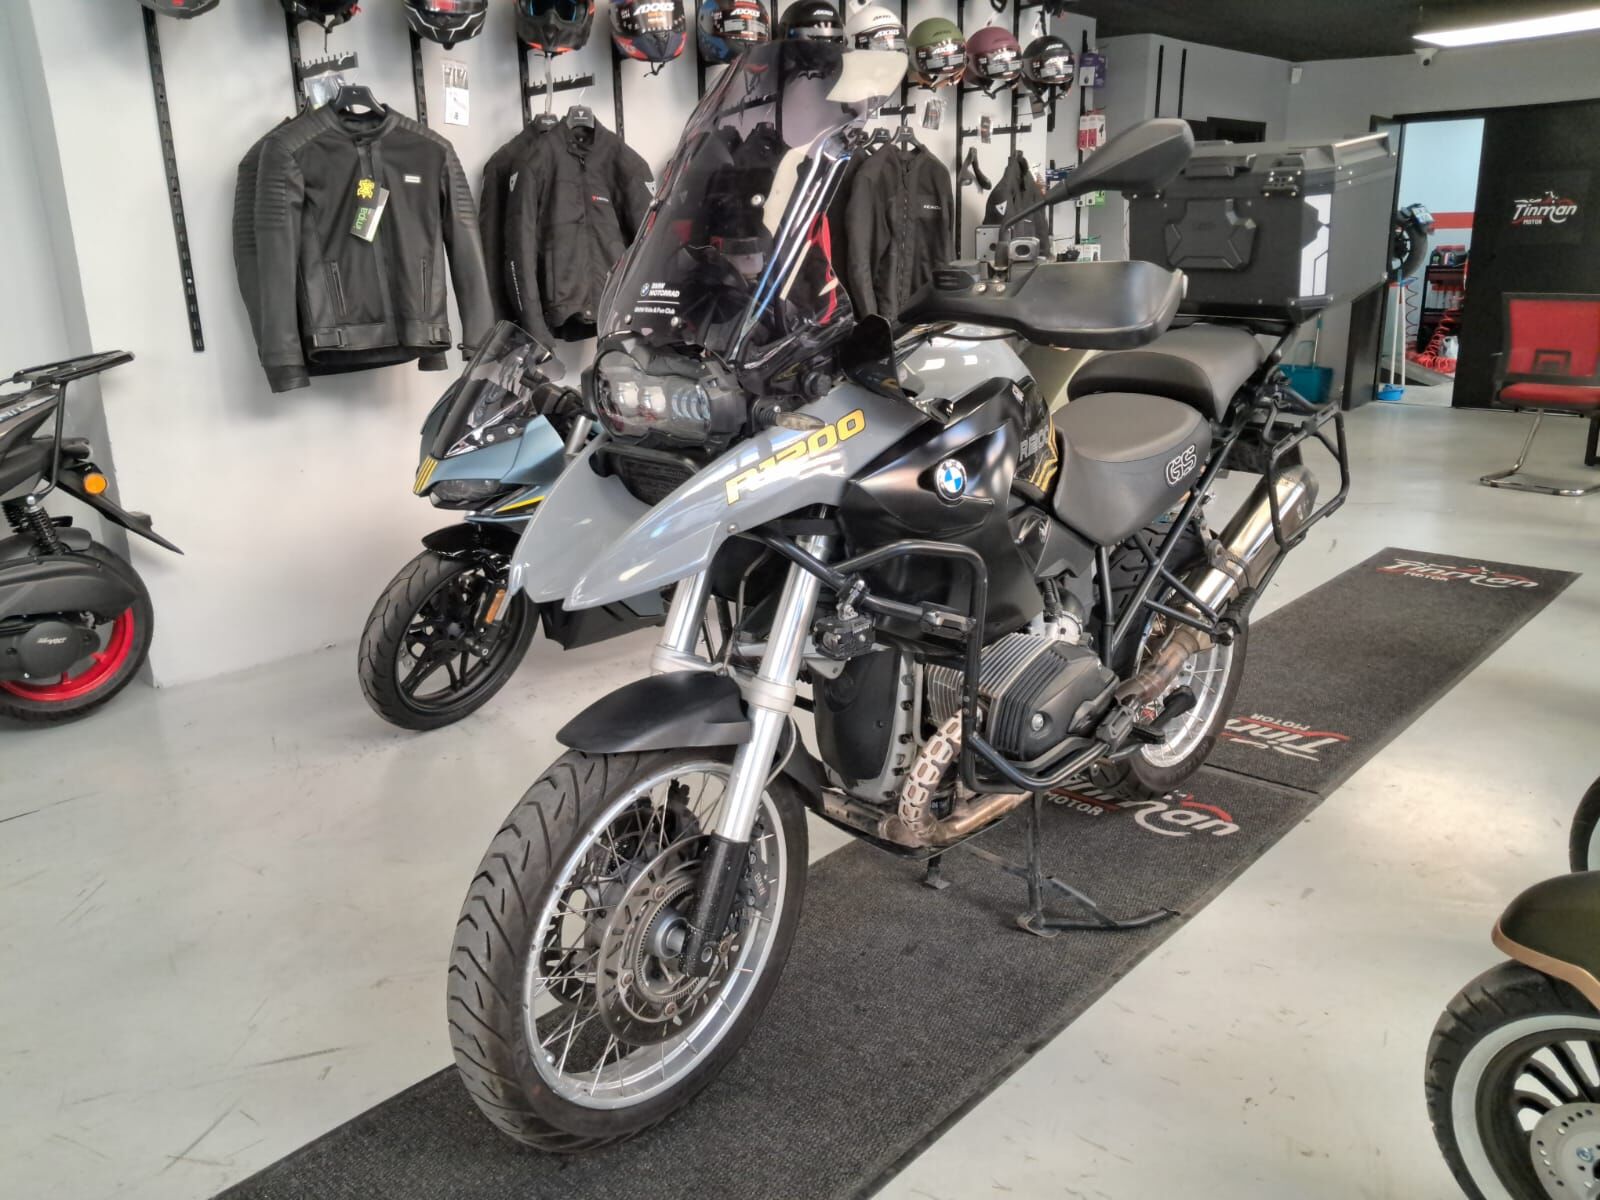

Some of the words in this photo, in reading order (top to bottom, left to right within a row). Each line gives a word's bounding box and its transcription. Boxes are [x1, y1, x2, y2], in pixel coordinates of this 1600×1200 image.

[1513, 203, 1578, 223] Tinman
[1166, 444, 1197, 485] GS
[1384, 560, 1539, 588] Tinman
[1403, 571, 1449, 582] MOTOR
[1250, 713, 1311, 731] MOTOR
